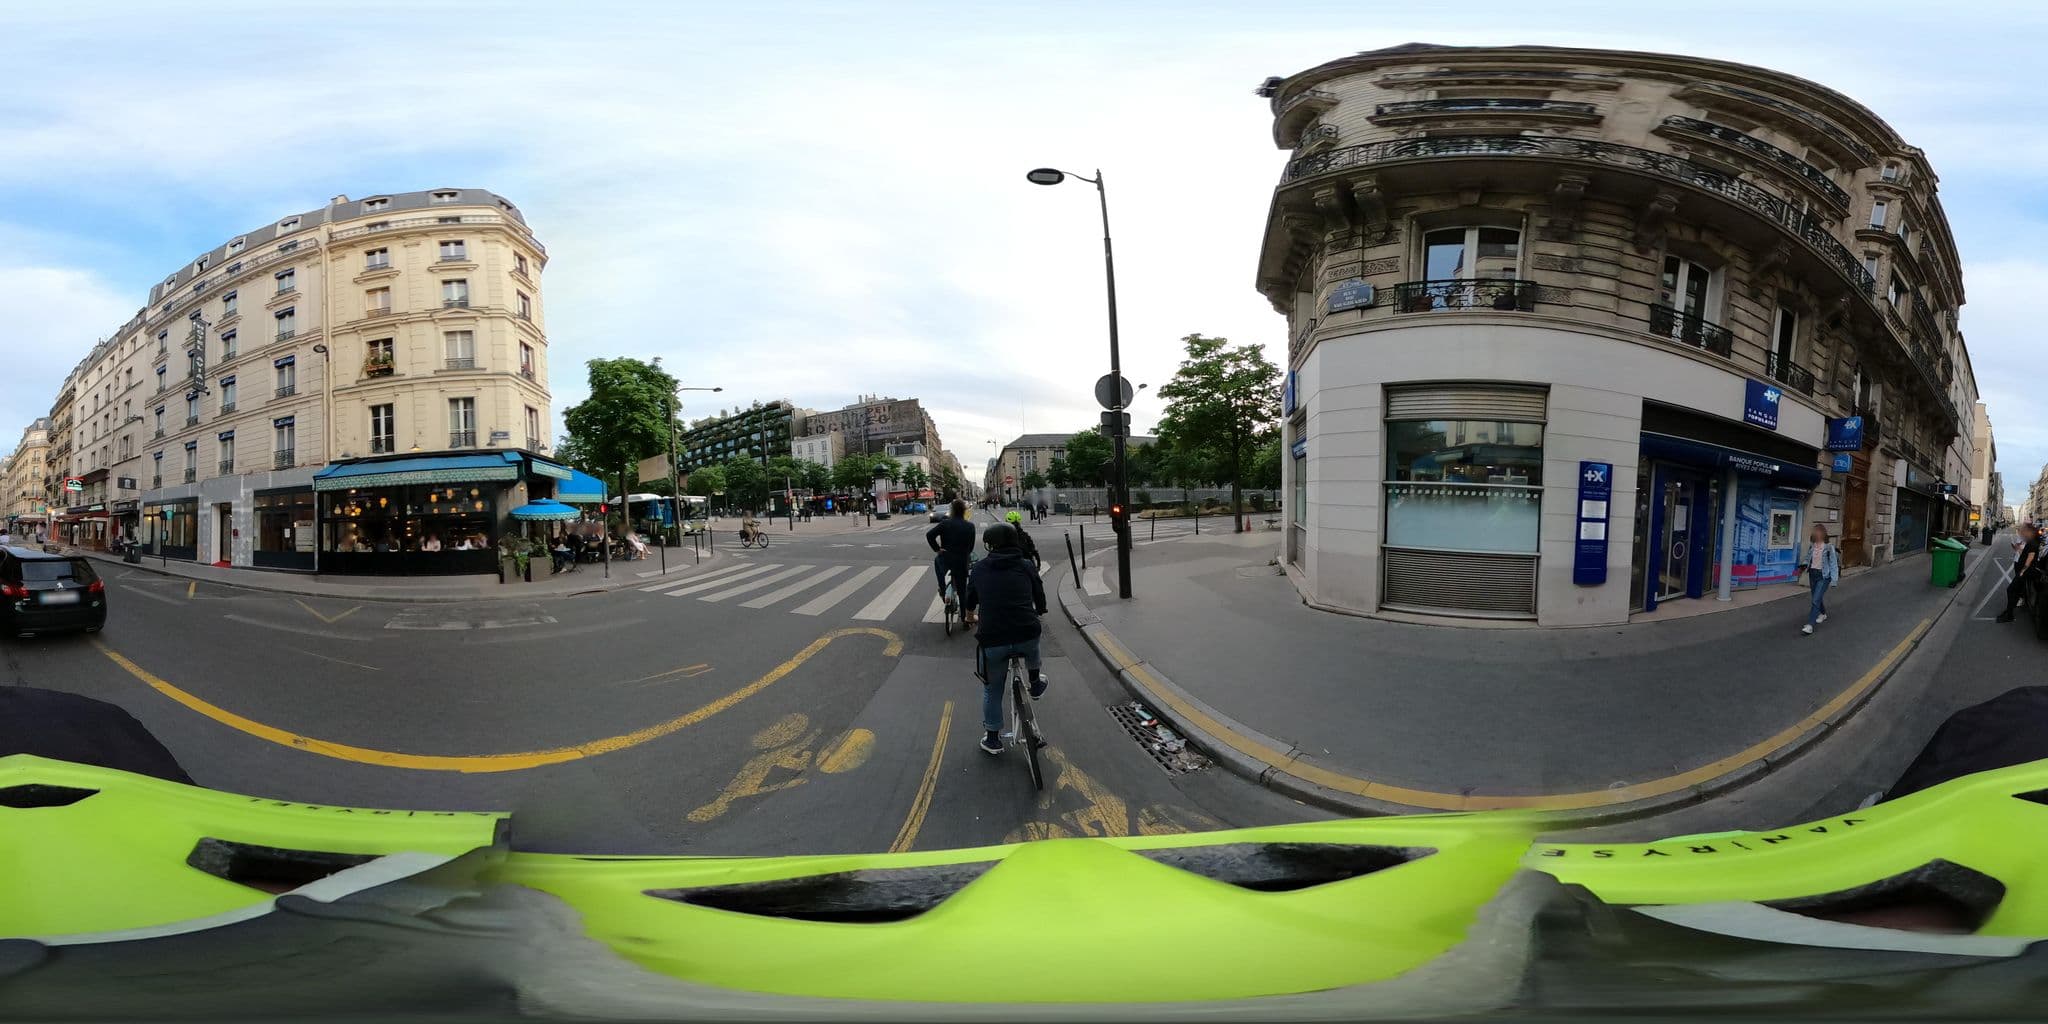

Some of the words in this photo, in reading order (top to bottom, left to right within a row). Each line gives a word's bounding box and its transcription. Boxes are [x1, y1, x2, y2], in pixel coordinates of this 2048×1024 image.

[1747, 414, 1777, 427] POPULAIRE
[1748, 407, 1777, 422] BANQUE
[1729, 455, 1753, 466] BANQUE
[1761, 817, 1865, 845] VAN
